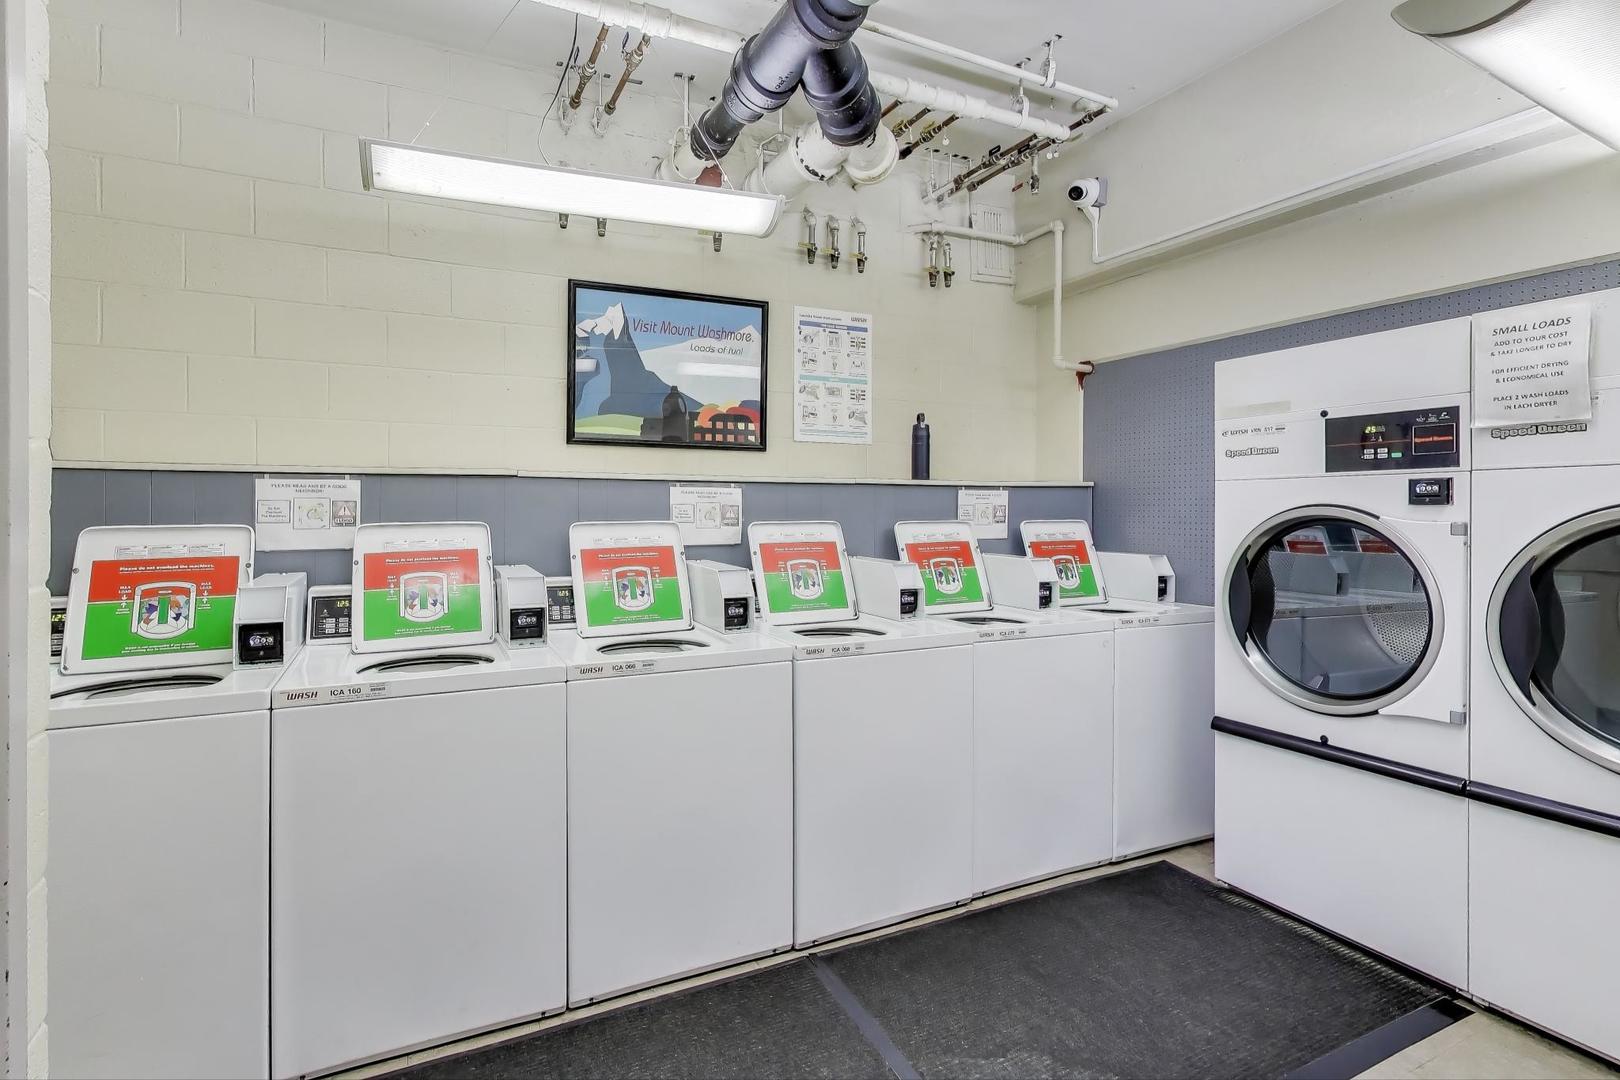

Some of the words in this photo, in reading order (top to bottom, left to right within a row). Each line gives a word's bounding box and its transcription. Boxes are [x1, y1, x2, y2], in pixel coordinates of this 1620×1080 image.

[632, 318, 657, 334] Visit
[659, 320, 695, 337] Mount
[1492, 323, 1529, 337] SMALL
[1532, 316, 1573, 330] LOADS
[1525, 334, 1547, 343] YOUR
[1548, 331, 1568, 340] COST
[690, 343, 715, 353] Loads
[717, 345, 727, 354] of
[728, 346, 744, 356] fun!
[1515, 344, 1544, 354] LONGER
[1506, 364, 1539, 374] EFFICIENT
[1540, 360, 1570, 369] DRYING
[1502, 373, 1549, 383] ECONOMICAL
[1521, 392, 1543, 400] WASH
[1544, 389, 1569, 397] LOADS
[1533, 400, 1558, 408] DRYER
[1491, 424, 1538, 440] Speed
[1537, 422, 1587, 434] Queen
[1225, 446, 1252, 459] Speed
[1251, 446, 1280, 456] Queen
[579, 666, 604, 675] WASH
[286, 691, 318, 701] WASH
[330, 689, 345, 697] ICA
[348, 687, 362, 695] 160
